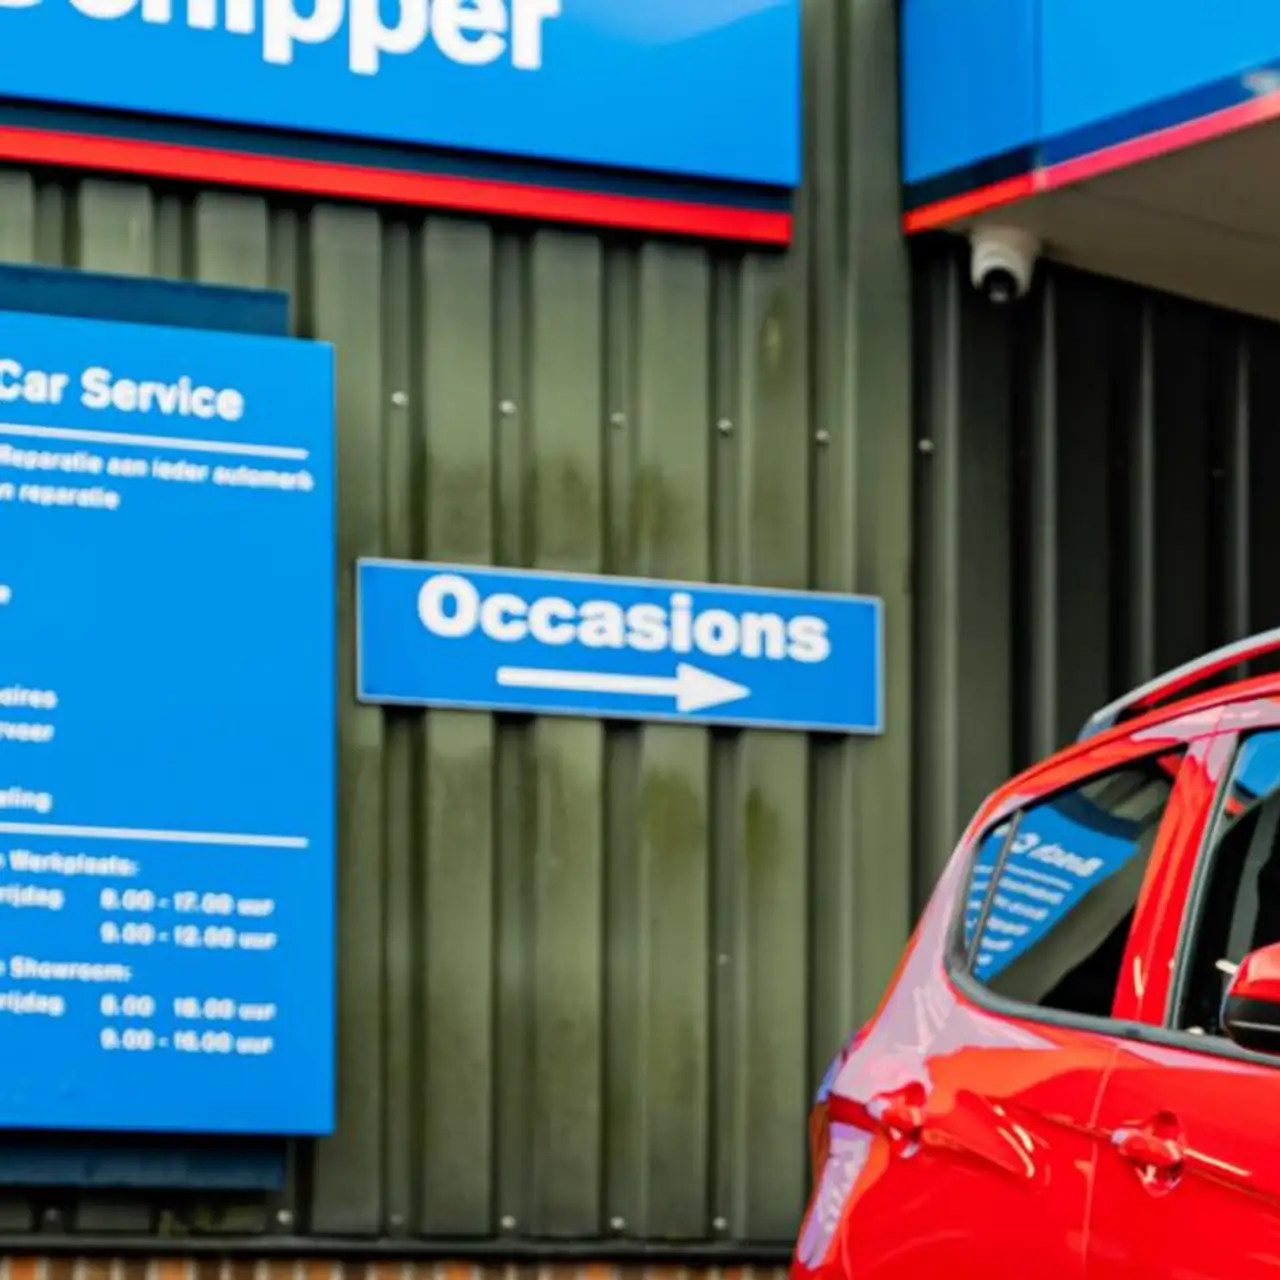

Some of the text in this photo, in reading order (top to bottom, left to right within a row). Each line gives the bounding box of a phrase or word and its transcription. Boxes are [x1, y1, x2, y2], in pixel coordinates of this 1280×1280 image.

[0, 359, 243, 420] Car Service
[417, 573, 831, 663] Occasions
[174, 892, 234, 915] 17.00
[237, 900, 273, 916] uur
[175, 926, 237, 947] 12.00
[238, 933, 276, 949] uur
[11, 956, 132, 981] Showroom:
[238, 1005, 274, 1020] uur
[236, 1038, 272, 1053] uur
